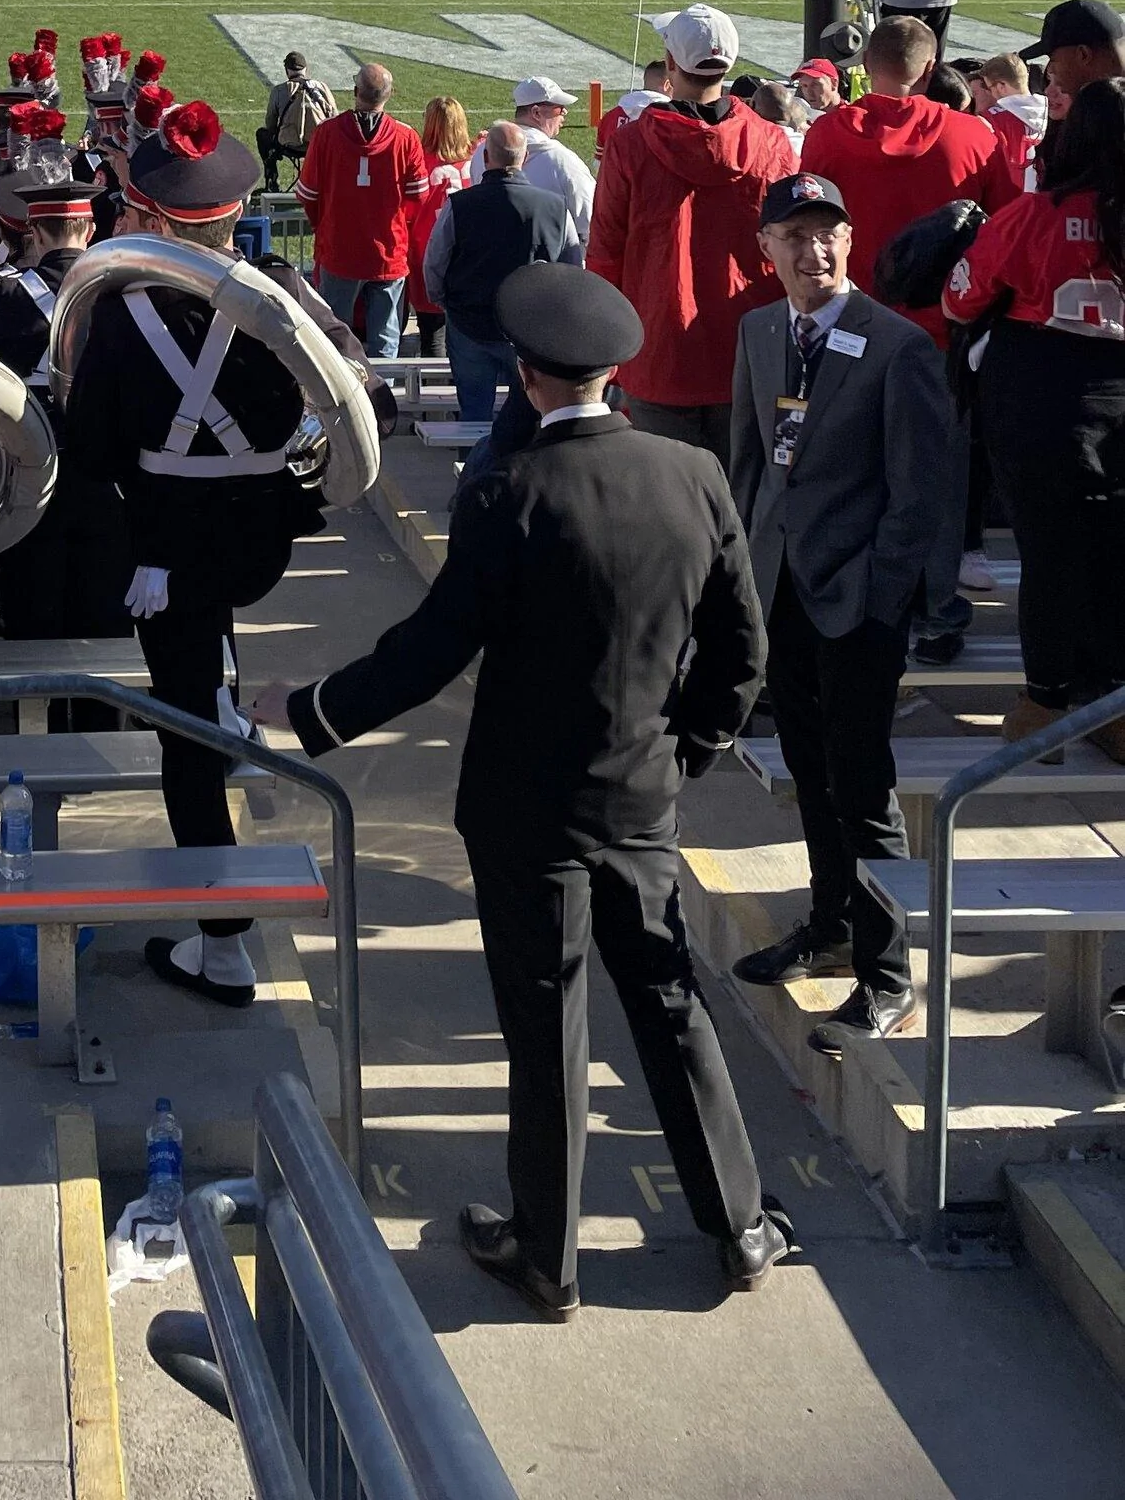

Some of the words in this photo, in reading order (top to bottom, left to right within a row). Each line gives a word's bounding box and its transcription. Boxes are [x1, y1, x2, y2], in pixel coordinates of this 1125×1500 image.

[356, 155, 372, 187] 1
[1065, 217, 1105, 242] BU
[370, 1163, 413, 1198] K
[788, 1155, 834, 1188] K
